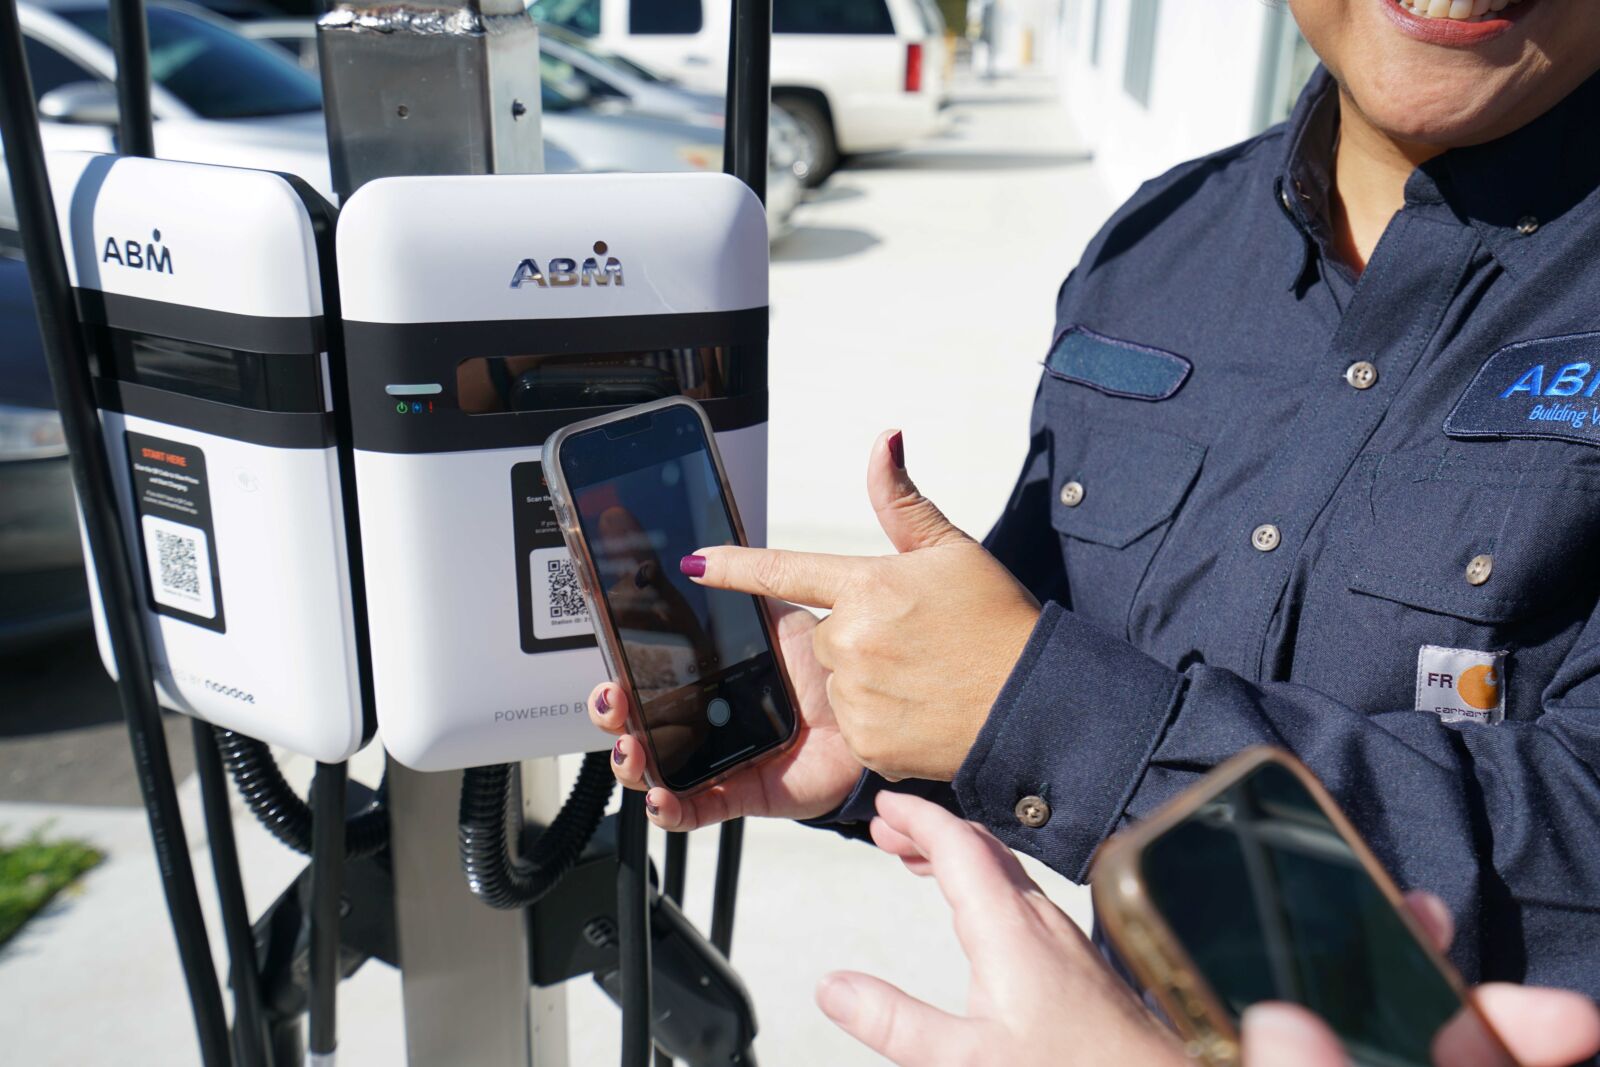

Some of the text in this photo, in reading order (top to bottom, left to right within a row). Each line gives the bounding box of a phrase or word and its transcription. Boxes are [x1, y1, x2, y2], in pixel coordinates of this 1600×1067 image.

[103, 228, 174, 275] ABM
[509, 240, 625, 289] ABM
[1528, 403, 1588, 428] Building
[1428, 672, 1453, 689] FR
[495, 704, 569, 722] POWERED
